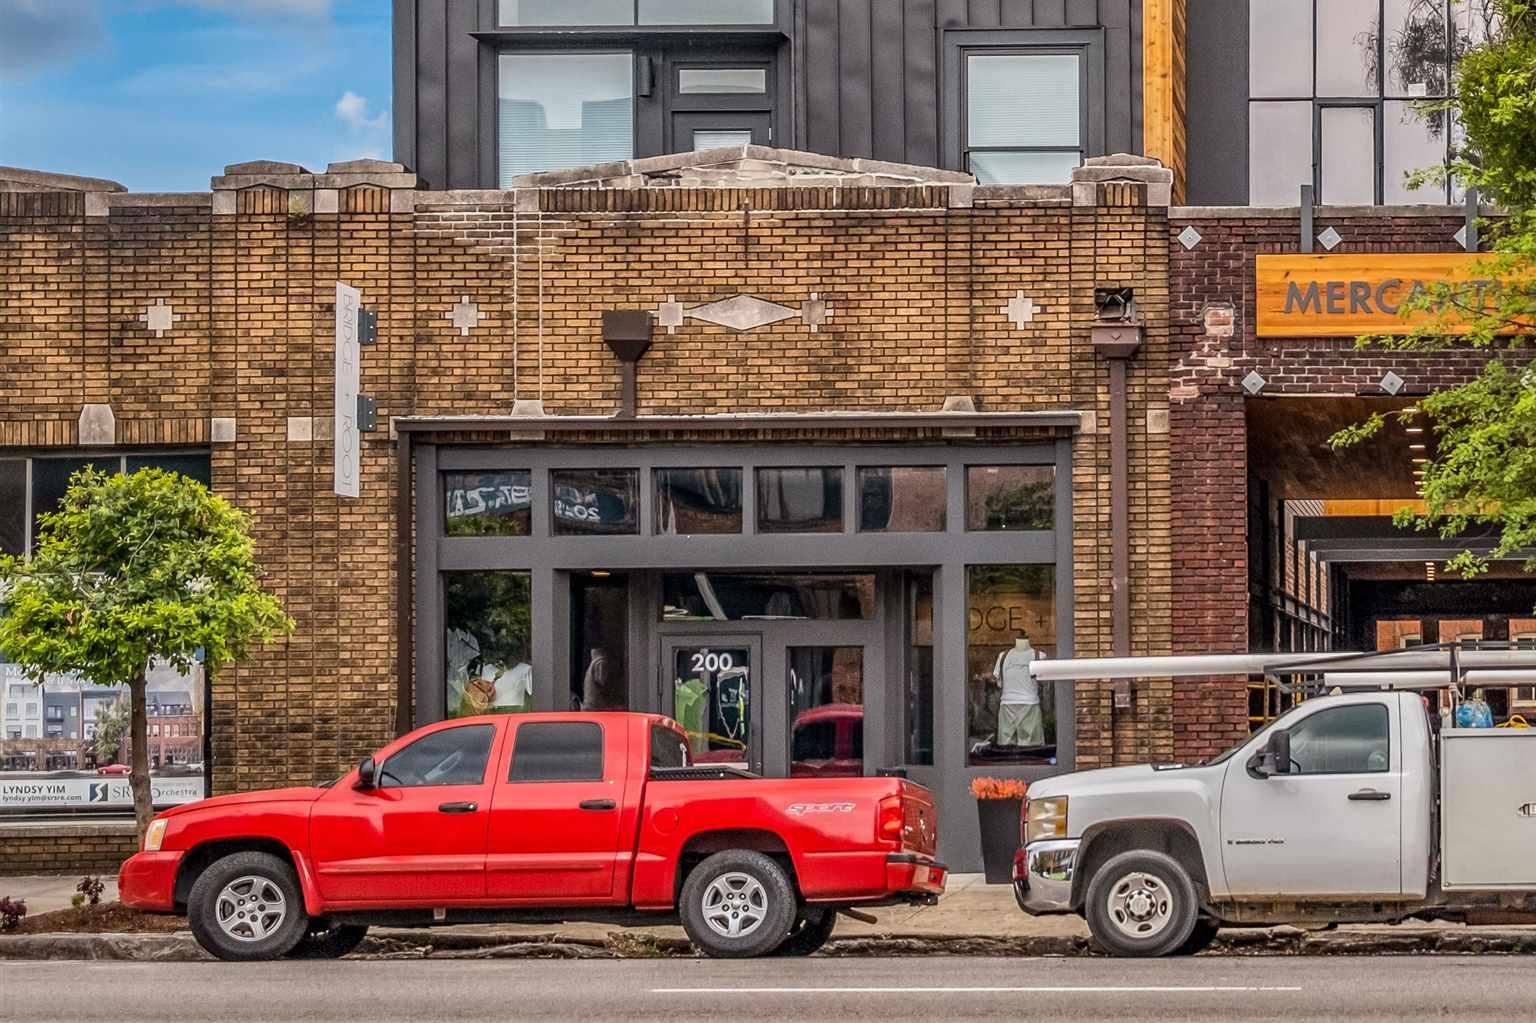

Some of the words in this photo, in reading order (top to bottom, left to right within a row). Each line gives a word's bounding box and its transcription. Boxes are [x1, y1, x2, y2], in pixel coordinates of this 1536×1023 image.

[690, 652, 734, 673] 200
[3, 785, 43, 794] LYNDSY
[46, 785, 66, 794] YIM
[112, 785, 130, 798] SR
